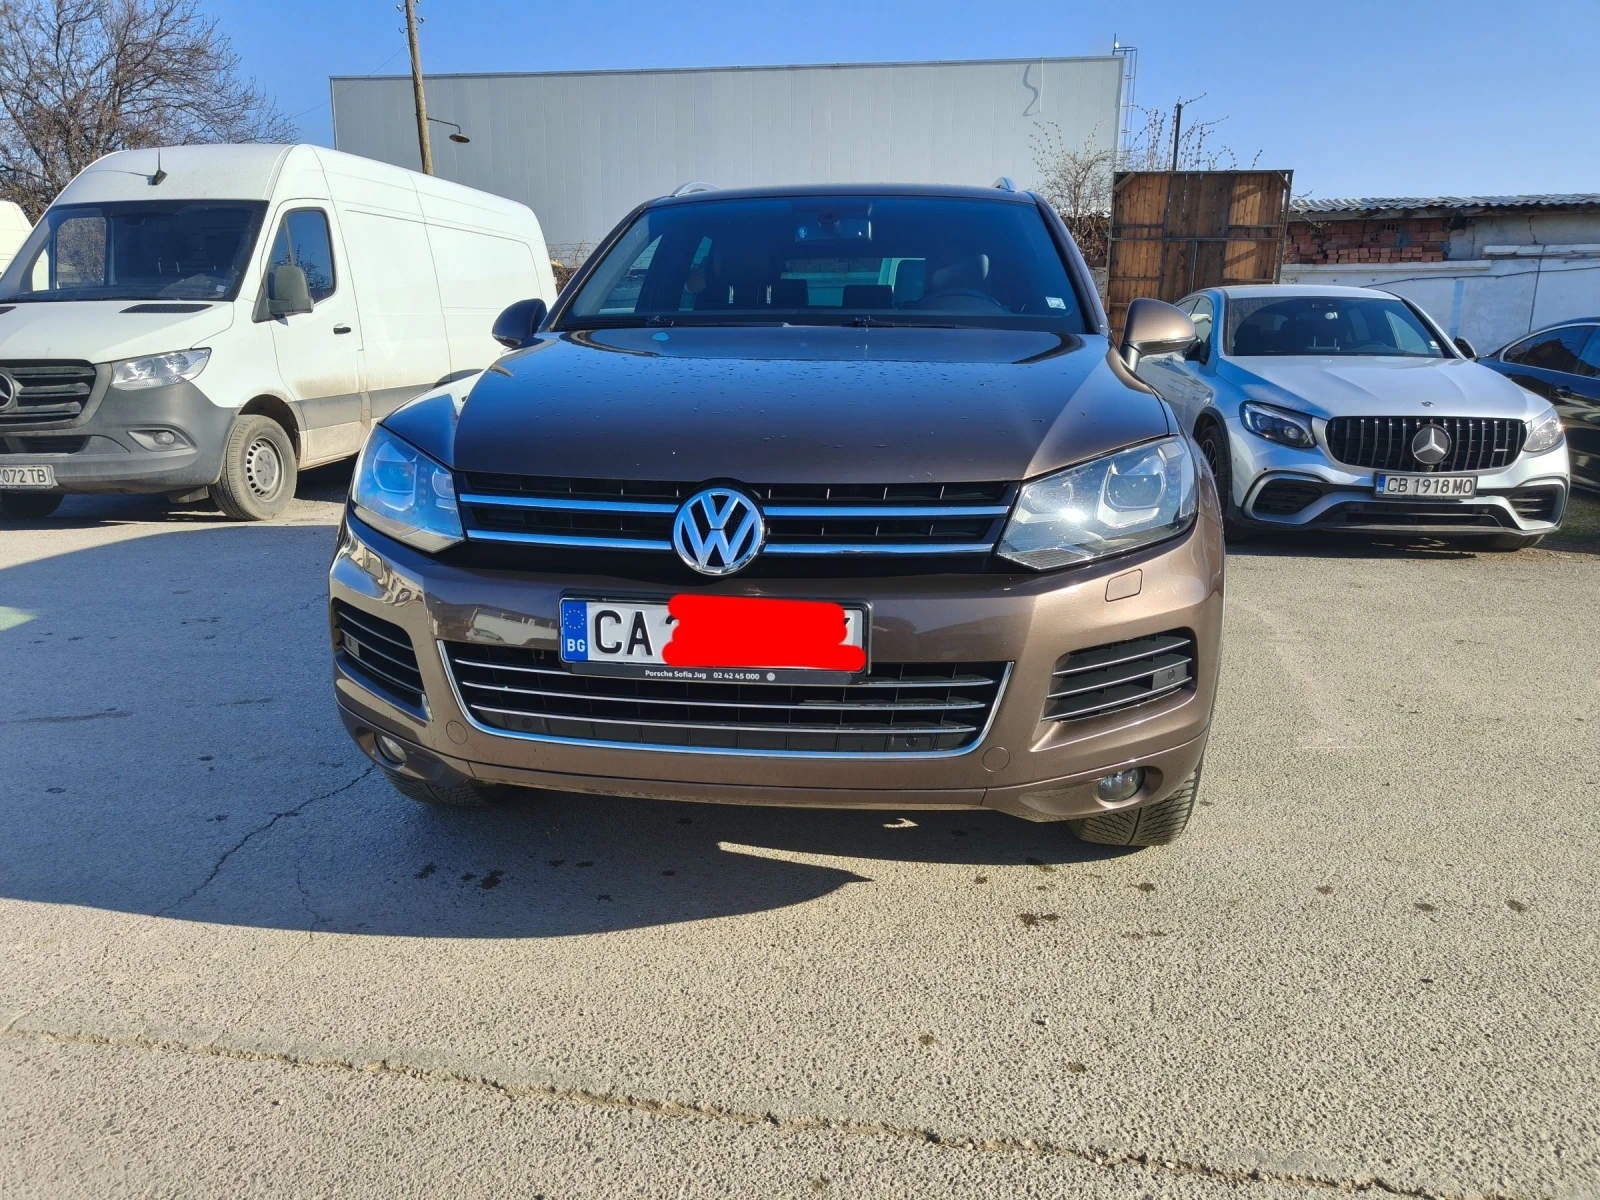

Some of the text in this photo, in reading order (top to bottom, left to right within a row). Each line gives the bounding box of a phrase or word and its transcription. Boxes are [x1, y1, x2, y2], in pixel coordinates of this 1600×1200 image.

[0, 469, 47, 483] 072 TB
[1387, 477, 1473, 495] CB 1918 MO
[675, 488, 763, 575] VW
[594, 609, 654, 656] CA
[567, 638, 586, 652] BG
[645, 669, 673, 678] Porsche
[674, 670, 693, 678] Sofia
[693, 671, 707, 680] Jug
[723, 672, 734, 680] 42
